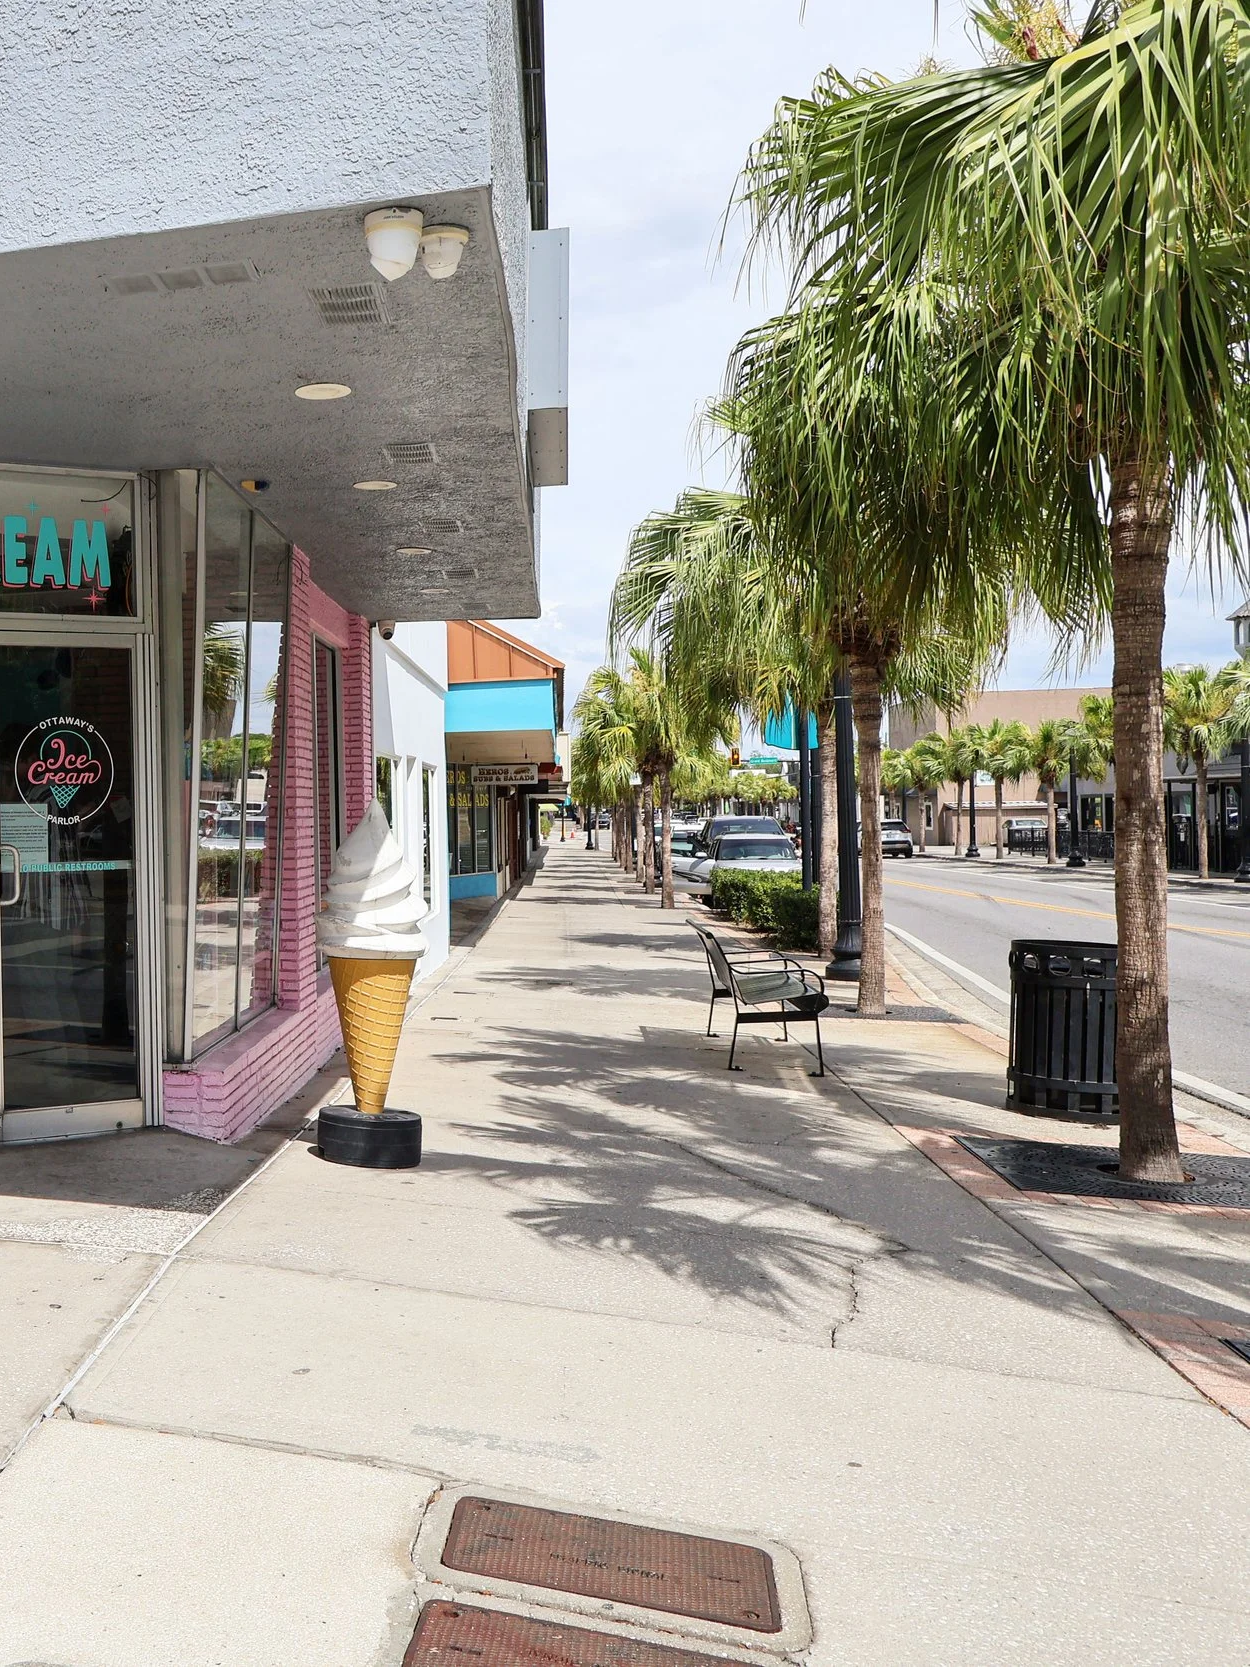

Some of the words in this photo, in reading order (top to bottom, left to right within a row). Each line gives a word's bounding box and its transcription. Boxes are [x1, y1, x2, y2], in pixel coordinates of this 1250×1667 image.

[39, 716, 95, 734] OTTAWAY'S
[47, 738, 88, 770] Ice
[27, 757, 101, 785] Cream
[446, 769, 466, 785] ROS
[478, 768, 510, 776] HEROS
[449, 793, 455, 807] &
[457, 792, 490, 807] SALADS
[45, 814, 81, 826] PARLOR
[31, 863, 63, 873] PUBLIC
[65, 861, 116, 872] RESTROOMS
